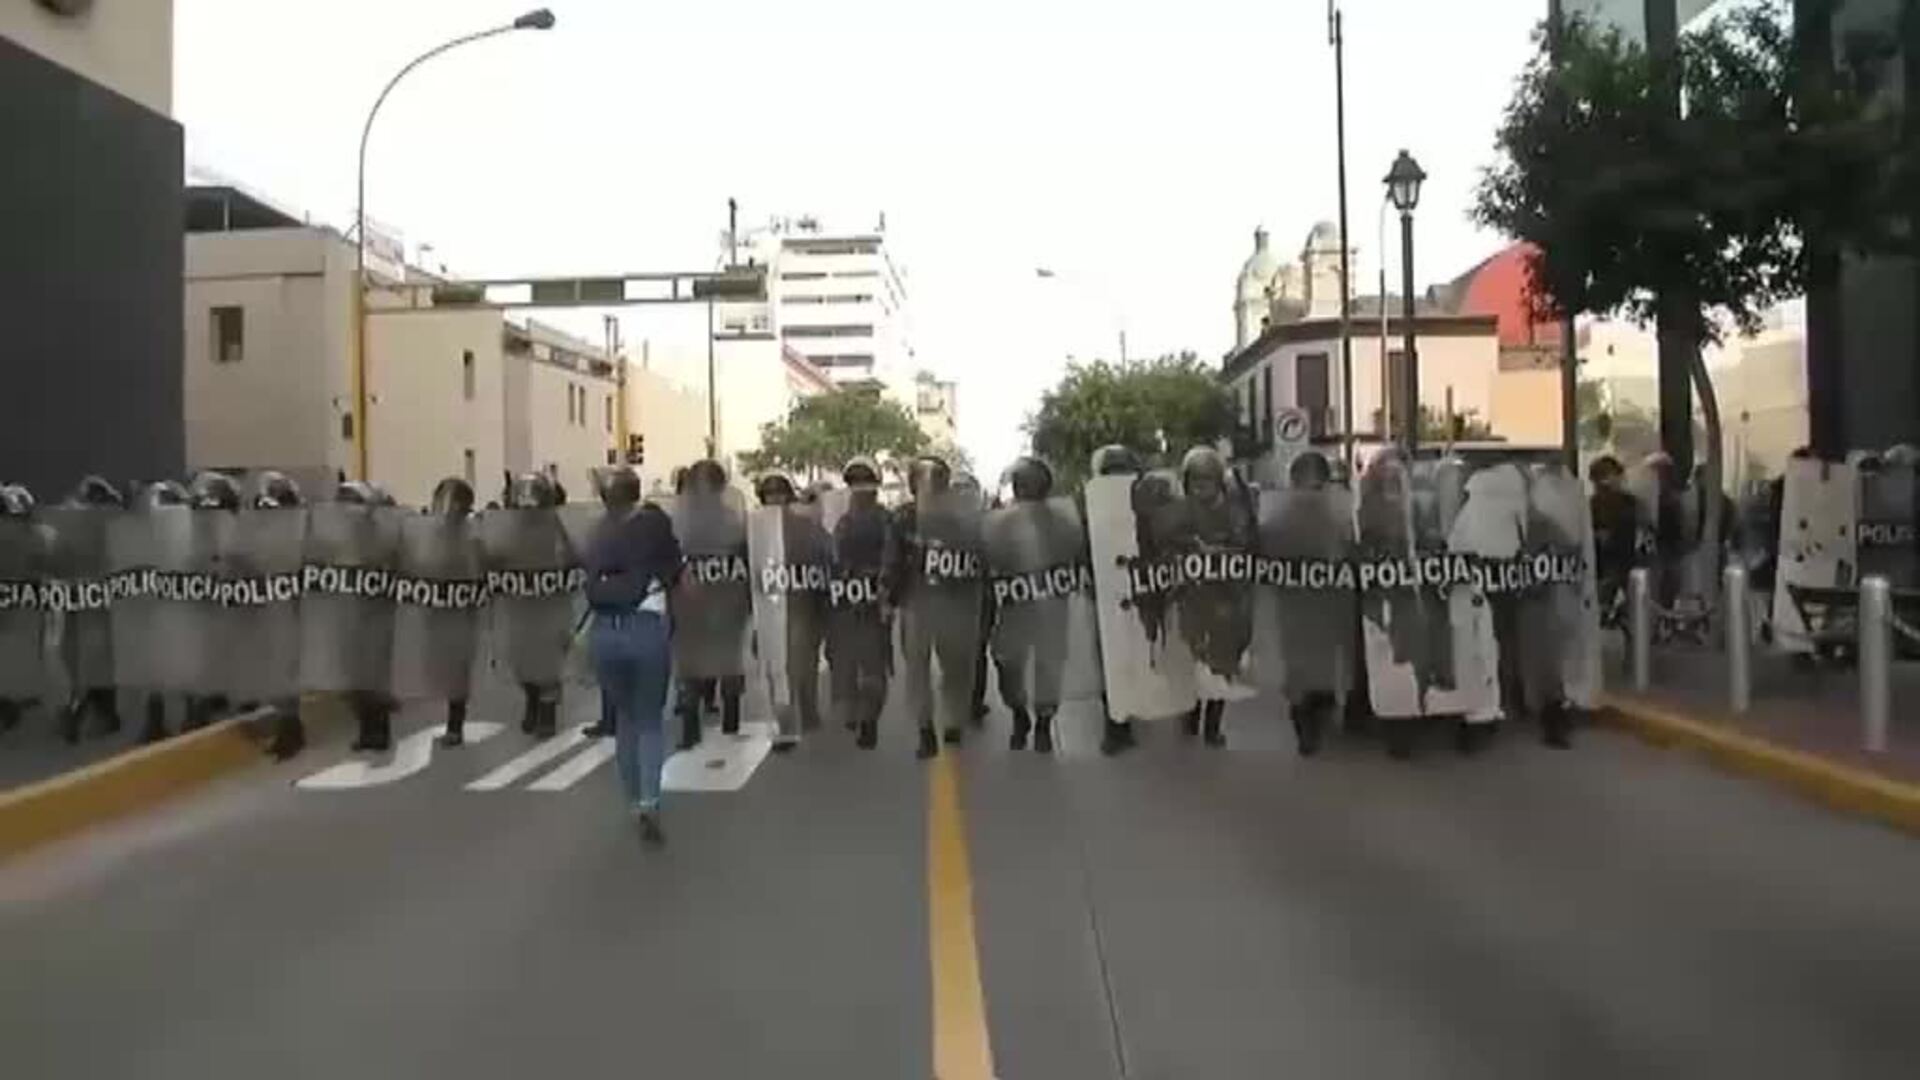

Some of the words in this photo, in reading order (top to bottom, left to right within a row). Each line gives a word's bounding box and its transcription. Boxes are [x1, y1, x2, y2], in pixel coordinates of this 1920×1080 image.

[993, 562, 1093, 606] POLICIA
[1255, 557, 1356, 589] POLICIA
[1360, 554, 1470, 592] POLICIA
